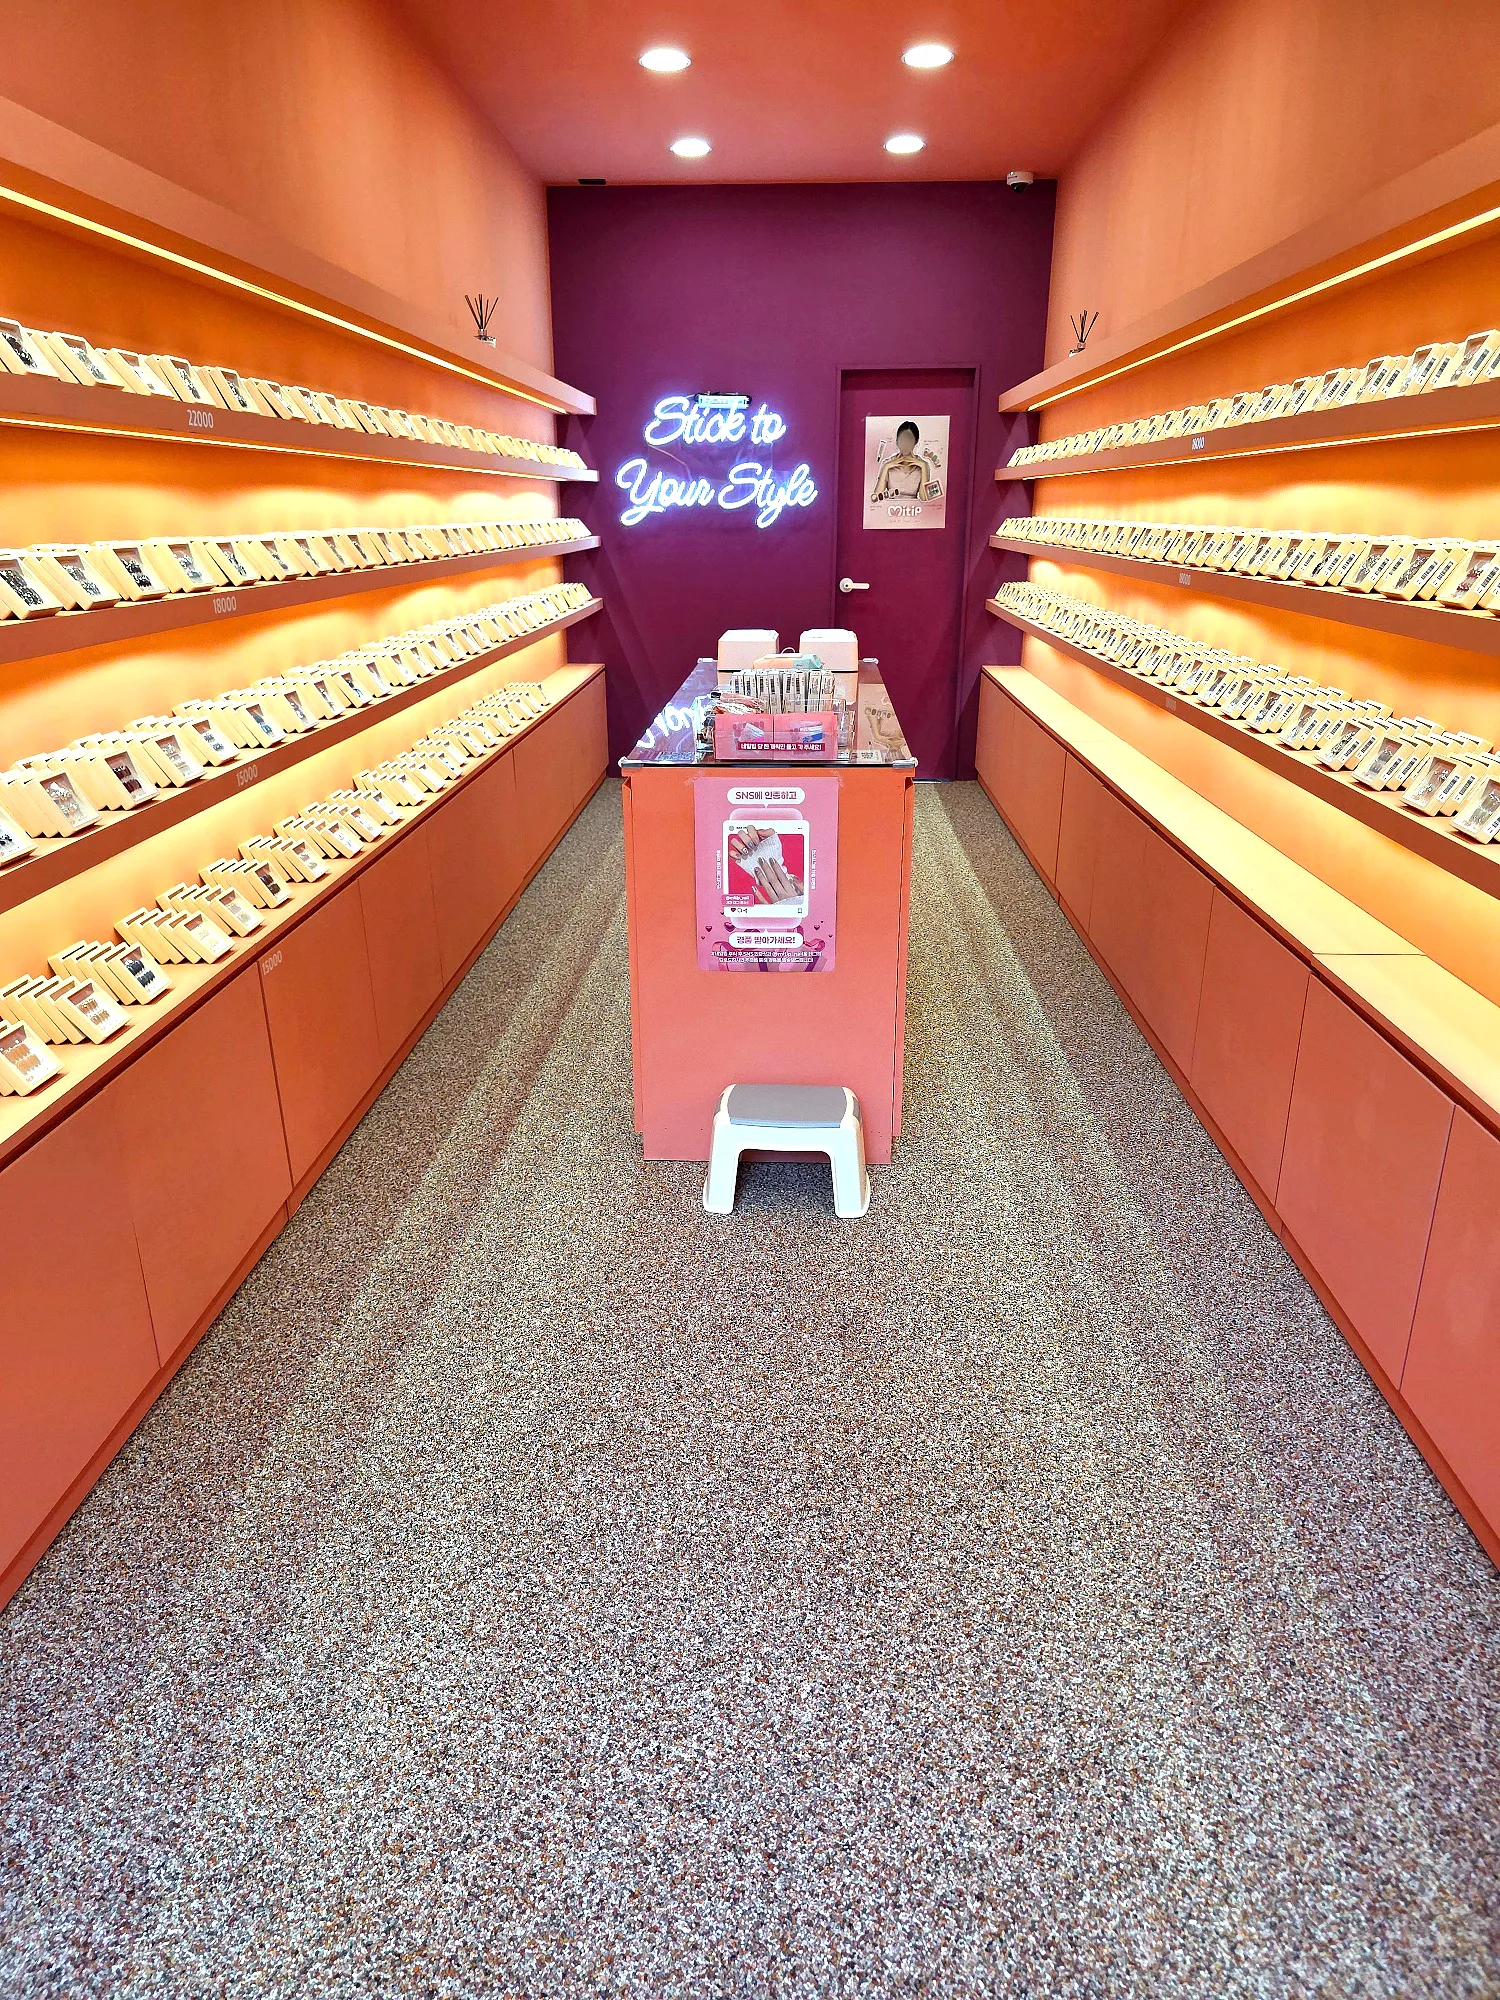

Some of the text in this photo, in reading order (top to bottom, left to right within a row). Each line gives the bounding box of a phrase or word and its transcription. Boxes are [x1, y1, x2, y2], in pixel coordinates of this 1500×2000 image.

[187, 409, 214, 429] 22000
[644, 396, 787, 446] Stick to
[616, 458, 819, 529] Your Style
[212, 595, 237, 614] 18000
[236, 764, 258, 787] 15000
[735, 790, 797, 800] SNS에 인증하고
[262, 950, 283, 976] 15000
